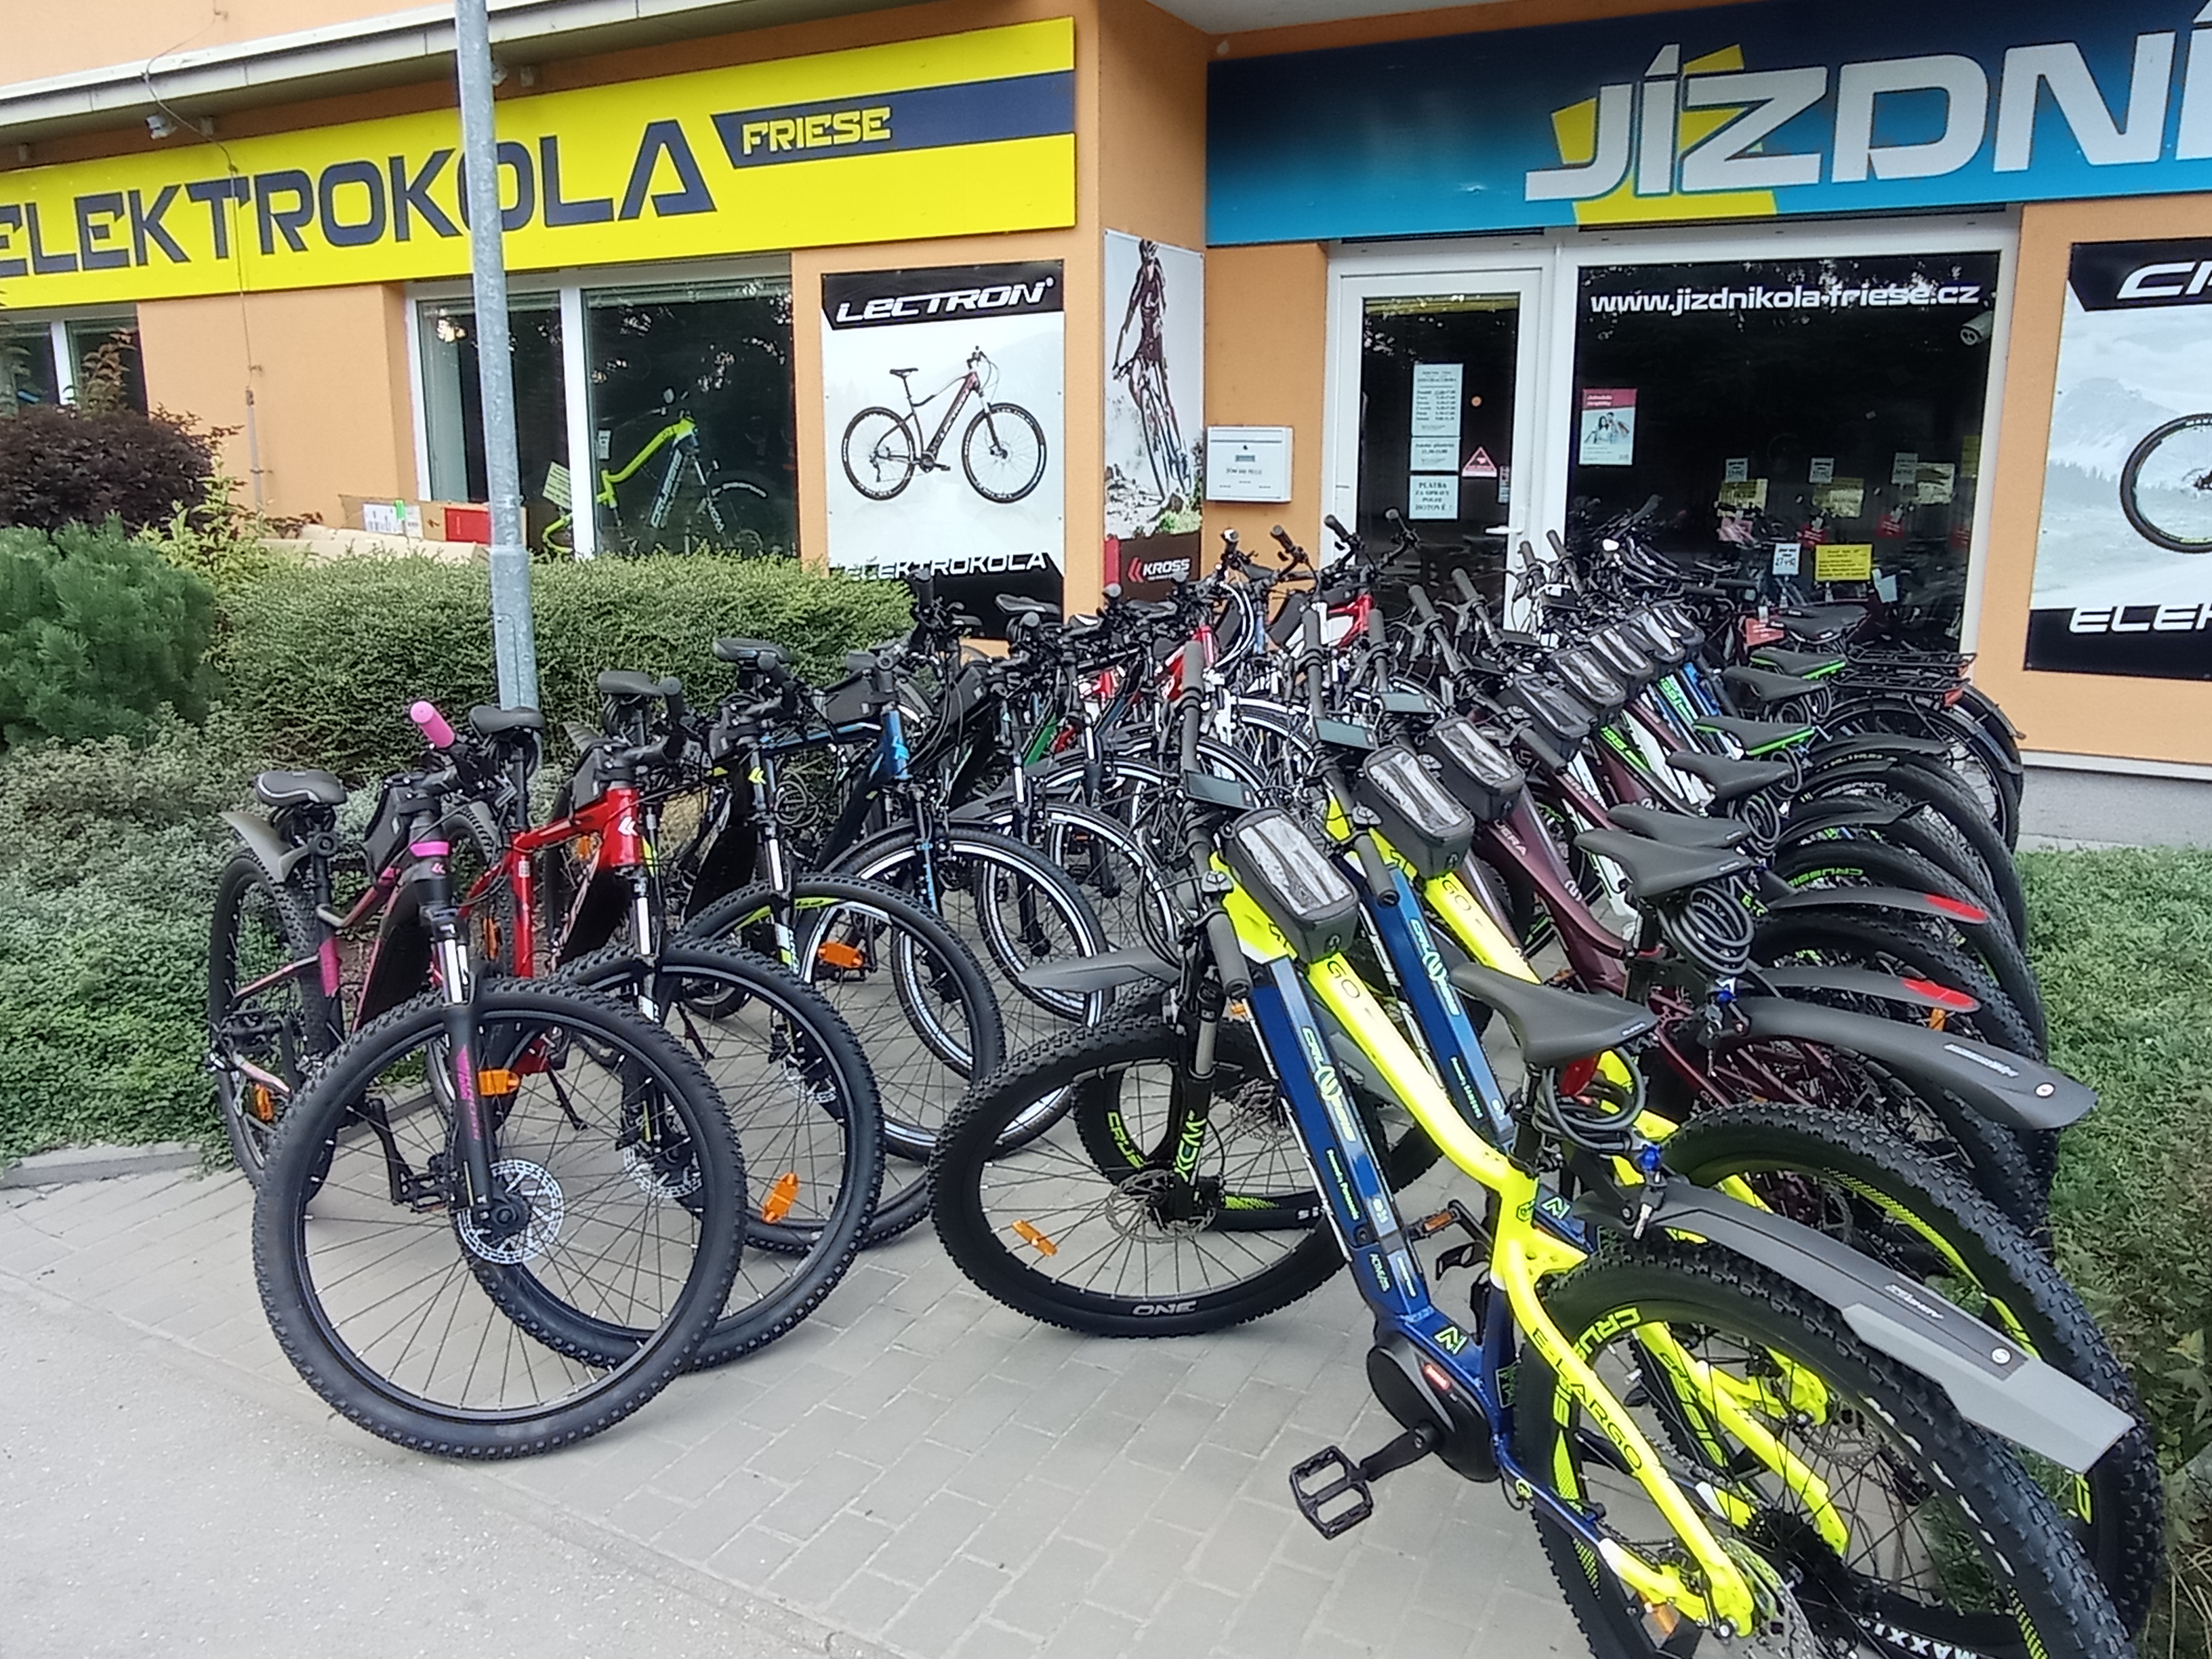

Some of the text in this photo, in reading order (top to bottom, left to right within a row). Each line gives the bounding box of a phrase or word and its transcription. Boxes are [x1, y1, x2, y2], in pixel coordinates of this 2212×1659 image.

[741, 106, 893, 156] FRIESE
[1143, 558, 1191, 576] KROSS
[1132, 1300, 1196, 1315] ONE
[1532, 1326, 1643, 1471] E-LARGO
